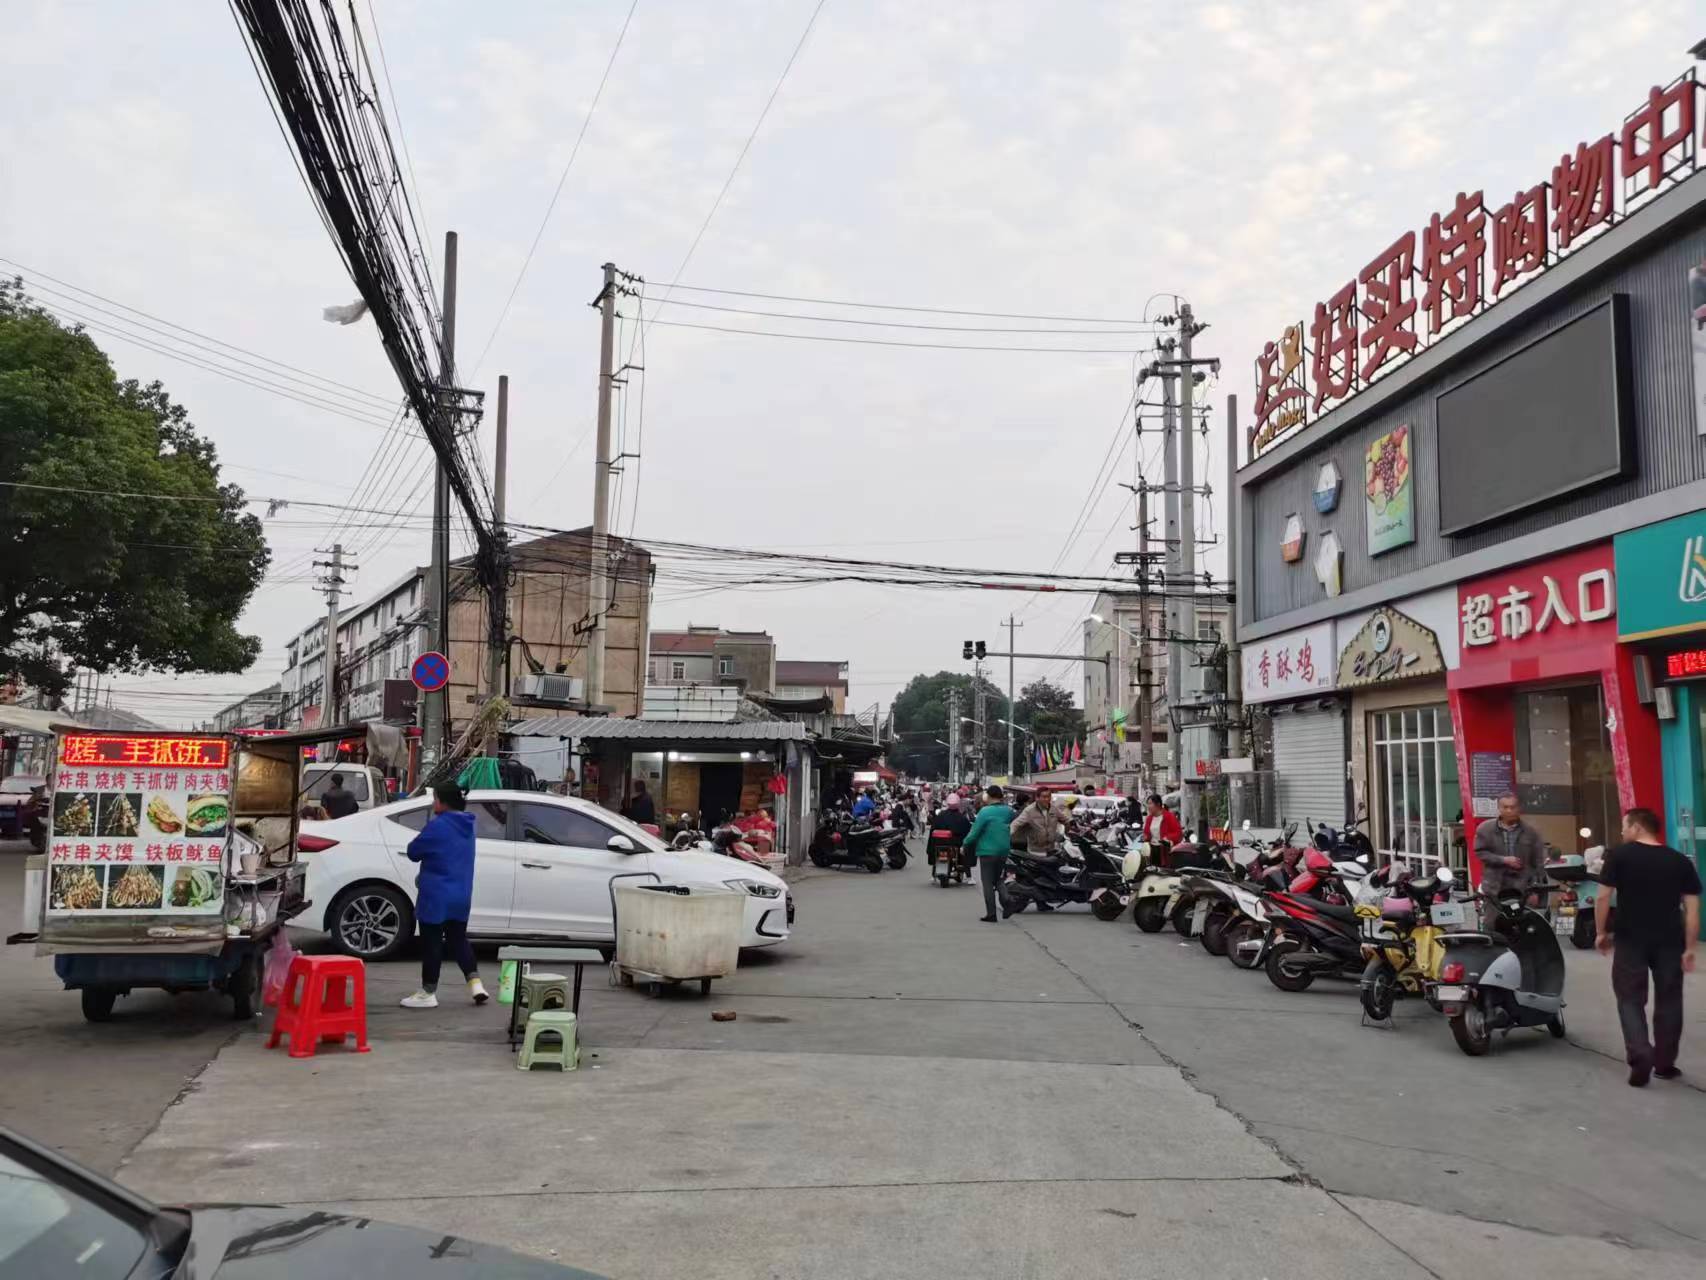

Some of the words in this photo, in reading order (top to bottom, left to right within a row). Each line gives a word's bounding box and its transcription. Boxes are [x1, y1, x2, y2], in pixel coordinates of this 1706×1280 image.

[1311, 81, 1706, 413] 好买特购物中
[1462, 568, 1615, 649] 超市入口
[1258, 638, 1314, 692] 香酥鸡
[57, 771, 88, 789] 炸串
[96, 771, 127, 790] 烧烤
[132, 772, 178, 790] 手抓饼
[52, 843, 134, 861] 炸串夹馍
[146, 843, 222, 862] 铁板鱿鱼
